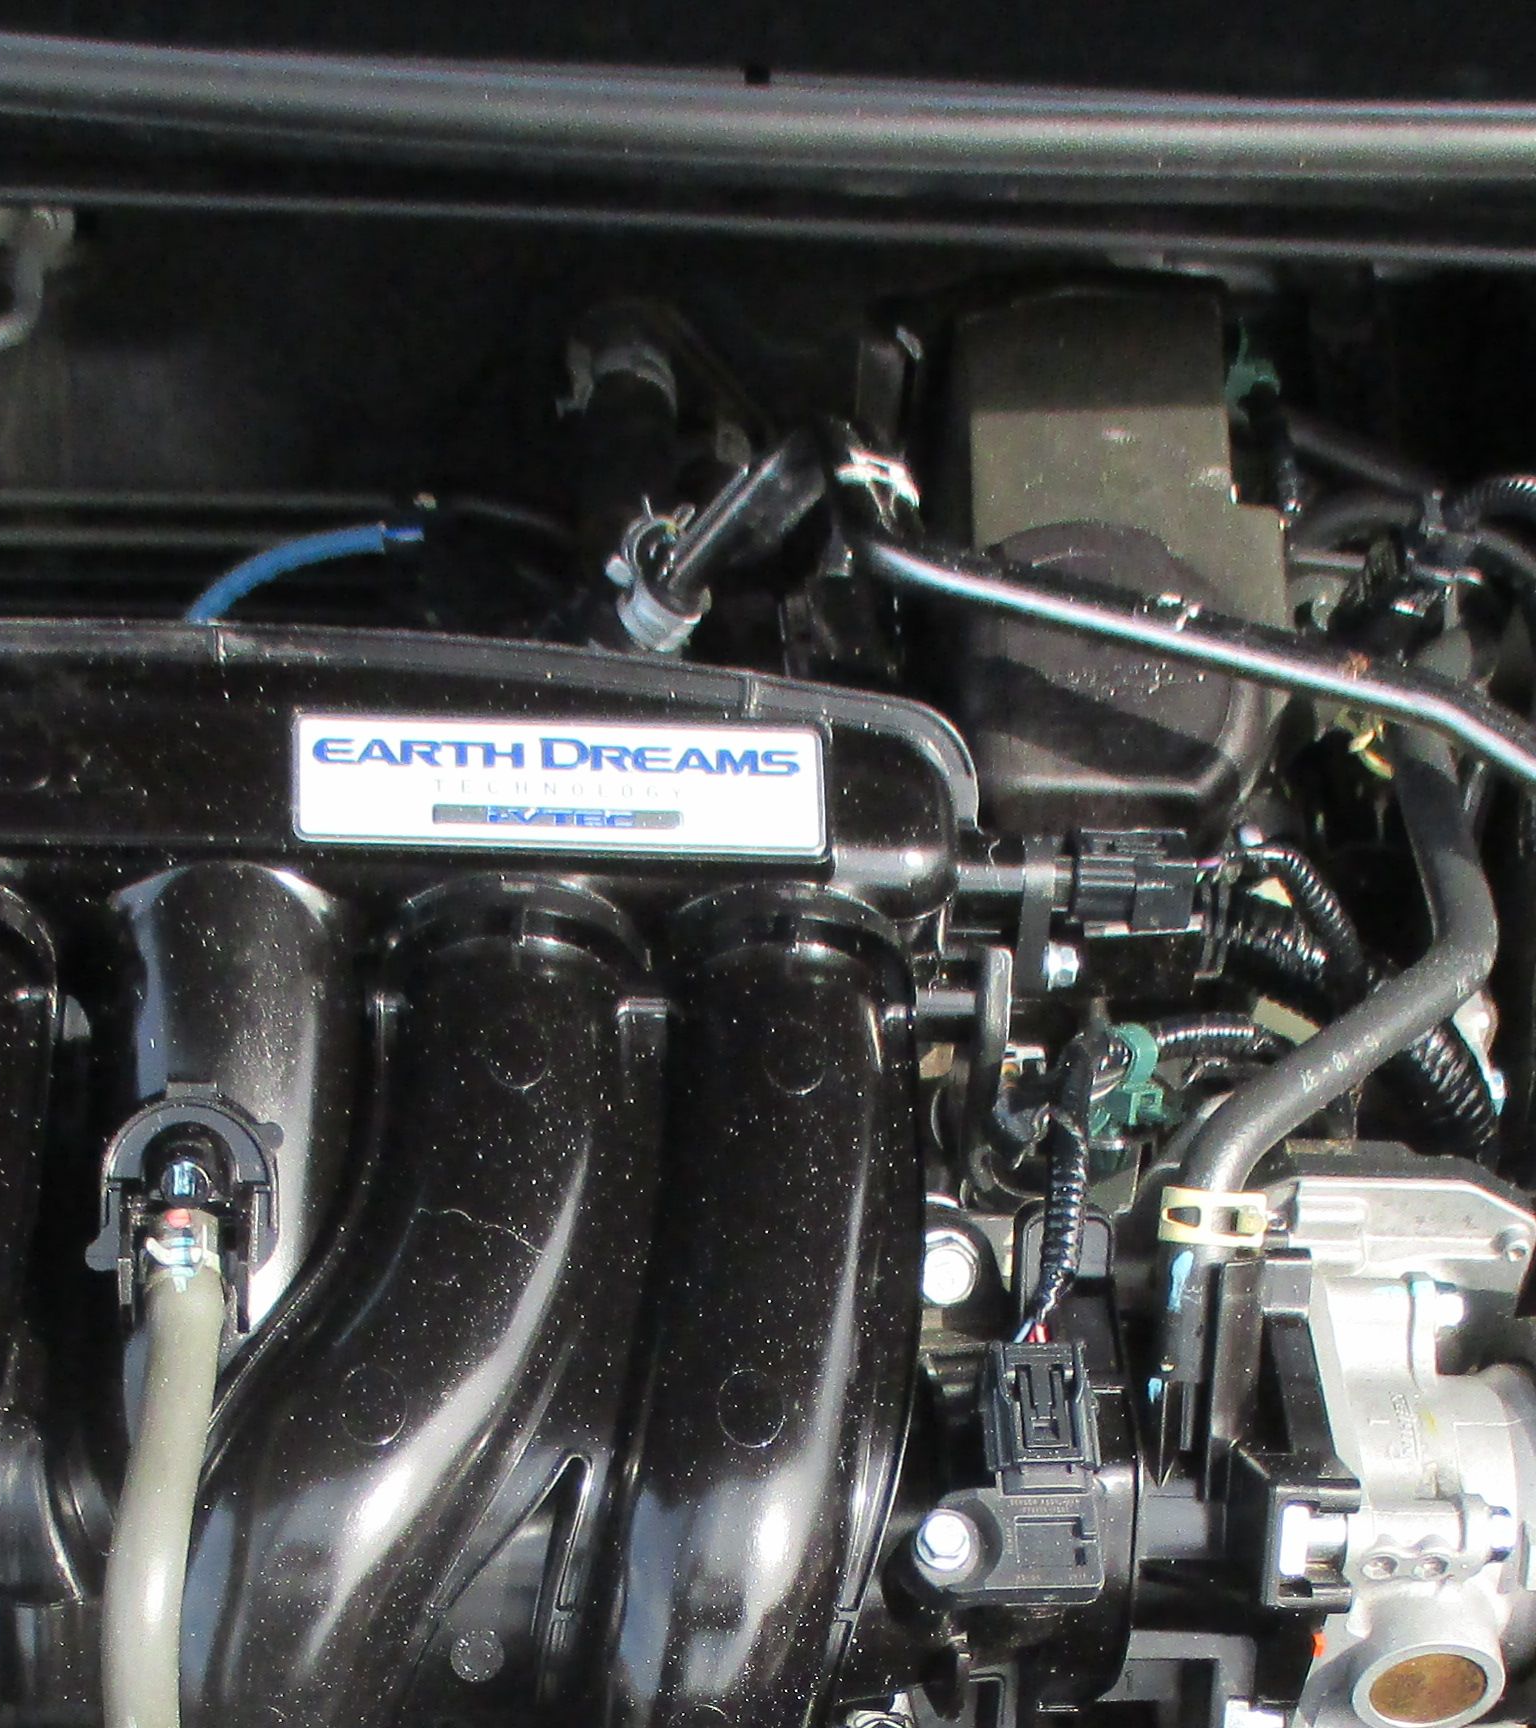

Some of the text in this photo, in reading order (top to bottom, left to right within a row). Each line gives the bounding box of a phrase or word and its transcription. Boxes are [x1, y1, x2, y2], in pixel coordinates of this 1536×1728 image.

[312, 736, 801, 776] EARTH DREAMS
[433, 777, 681, 800] TECHNOLOGY
